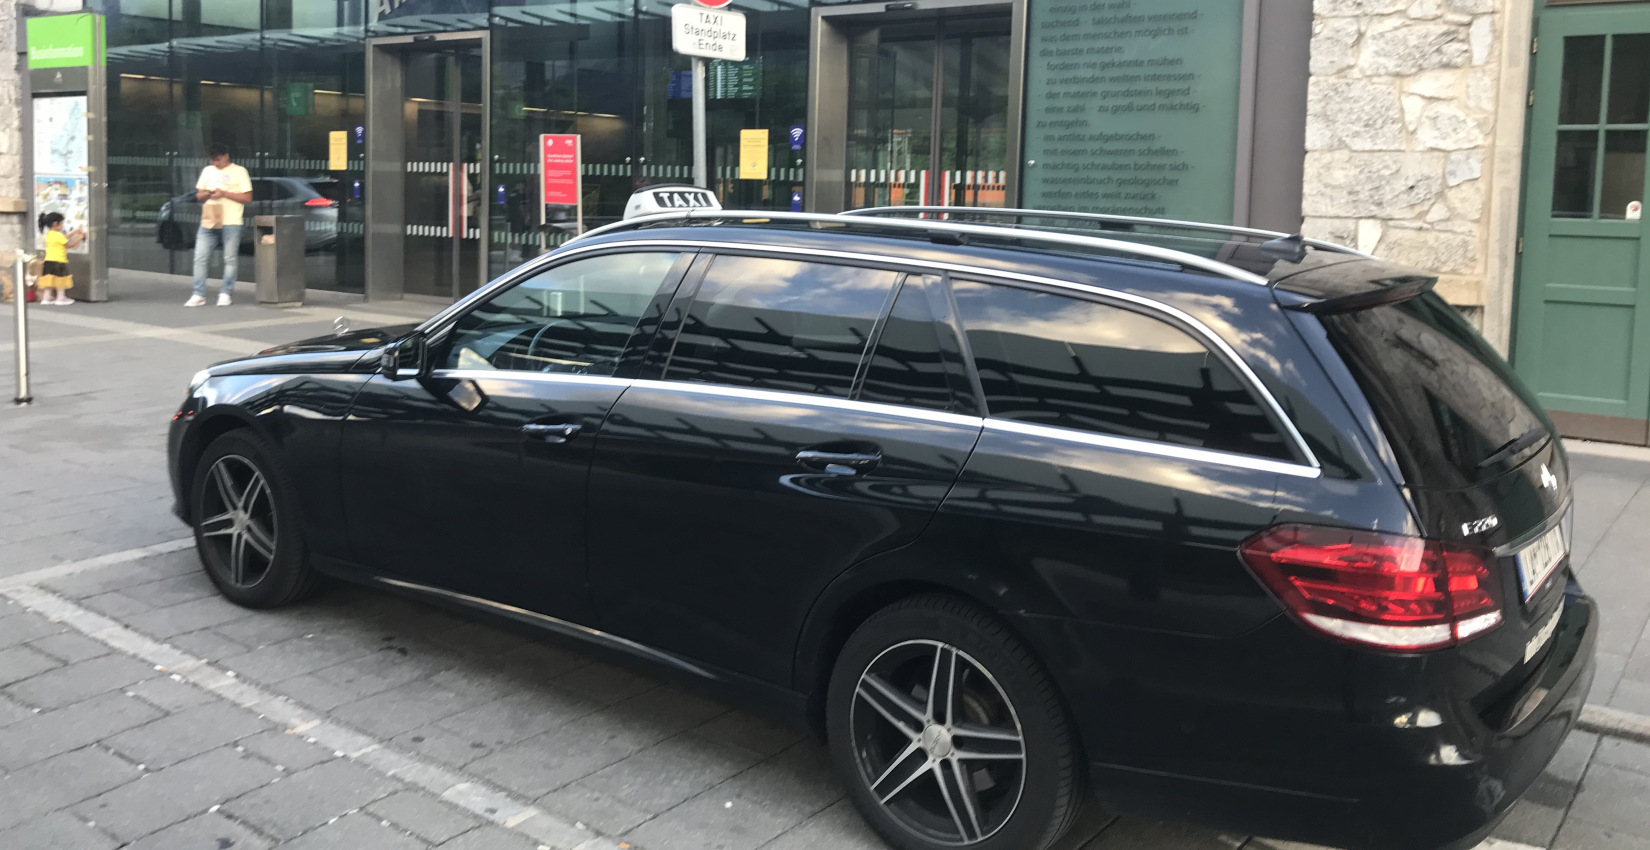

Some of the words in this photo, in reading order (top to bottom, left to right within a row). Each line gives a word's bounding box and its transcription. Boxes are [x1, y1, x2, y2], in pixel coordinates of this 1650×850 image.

[1090, 2, 1105, 11] der
[1108, 1, 1131, 9] wahl
[699, 12, 724, 26] TAXI
[1041, 18, 1079, 28] suchend
[1148, 10, 1198, 21] vereinend
[683, 23, 738, 43] Standplatz
[1041, 34, 1057, 43] was
[1060, 31, 1080, 42] dem
[1083, 28, 1132, 40] menschen
[1177, 26, 1189, 35] ist
[697, 40, 724, 53] Ende
[1039, 48, 1053, 57] die
[1046, 61, 1080, 71] fordern
[1099, 60, 1144, 70] gekannte
[1058, 75, 1105, 84] verbinden
[1144, 72, 1195, 81] interessen
[1045, 90, 1060, 99] der
[1063, 90, 1098, 99] materie
[1100, 88, 1153, 99] grundstein
[1156, 86, 1190, 98] legend
[1044, 105, 1064, 113] eine
[1067, 104, 1085, 113] zahl
[1111, 102, 1133, 115] groß
[1136, 103, 1156, 112] und
[1036, 120, 1046, 128] zu
[1043, 134, 1055, 142] im
[1088, 131, 1155, 144] aufgebrochen
[1043, 147, 1058, 156] mit
[1090, 148, 1135, 156] schweren
[1138, 147, 1178, 156] schellen
[1082, 162, 1131, 170] schrauben
[1169, 161, 1189, 170] sich
[1116, 176, 1179, 187] geologischer
[659, 190, 708, 209] TAXI
